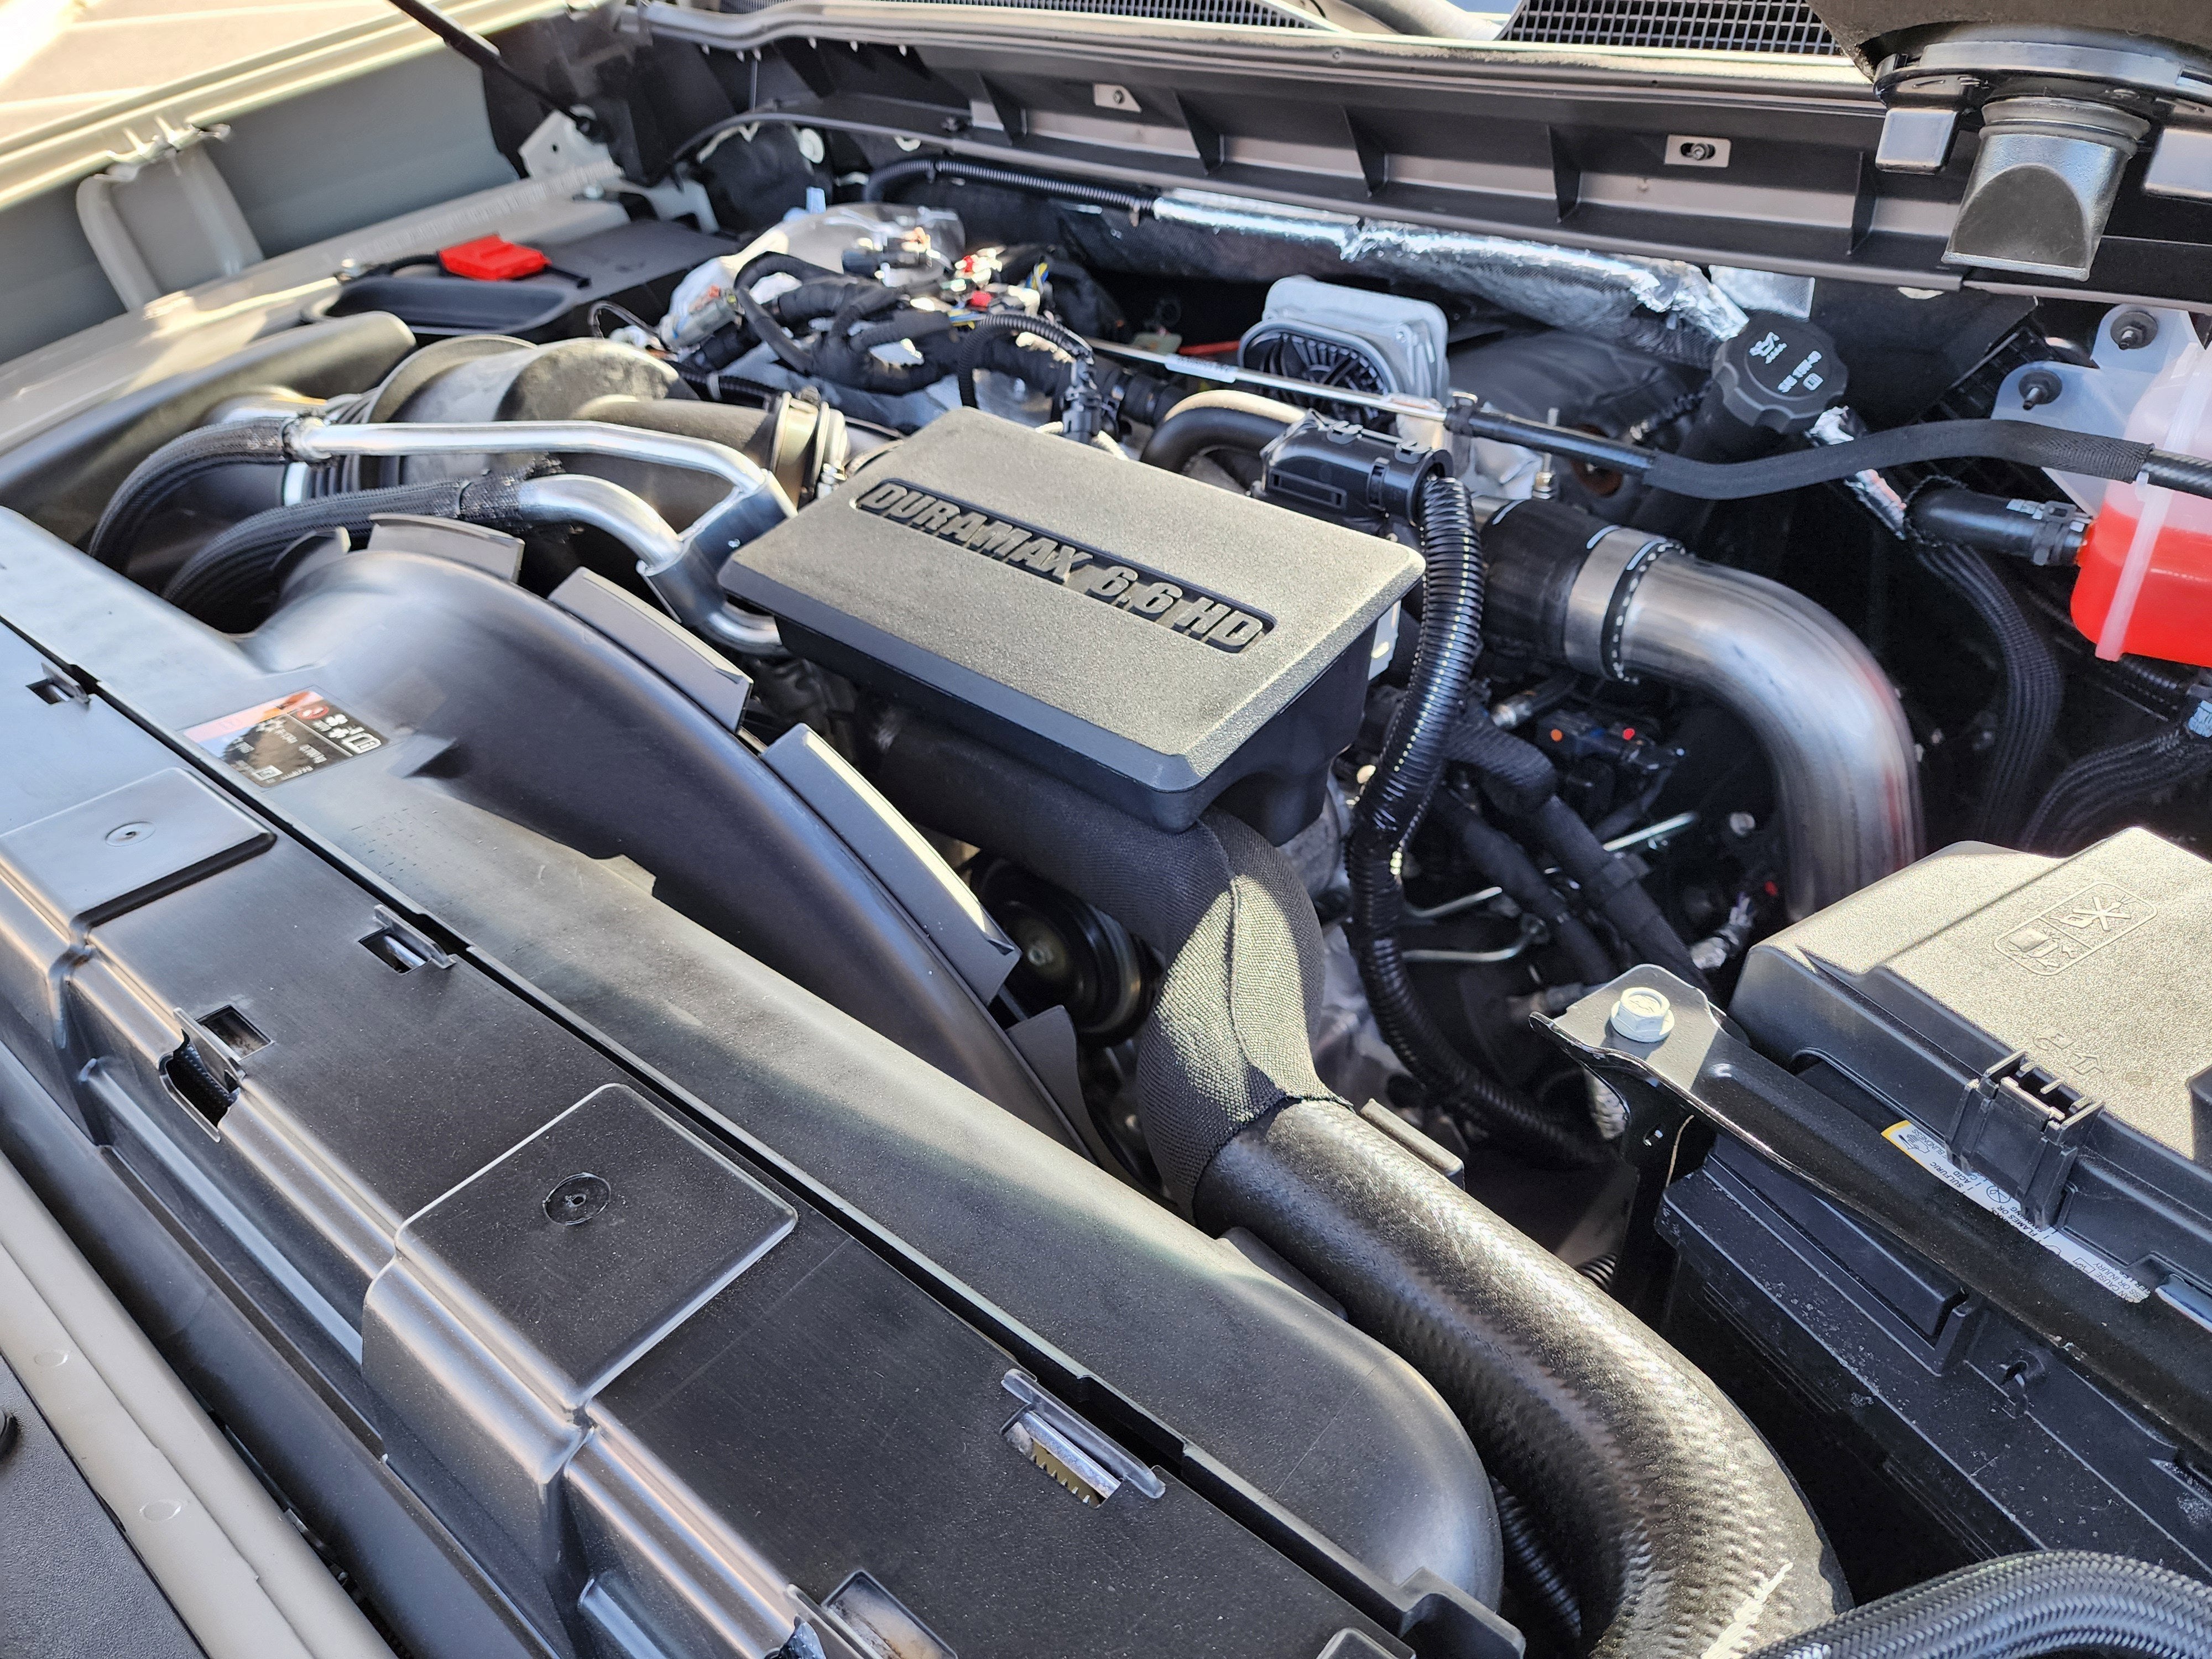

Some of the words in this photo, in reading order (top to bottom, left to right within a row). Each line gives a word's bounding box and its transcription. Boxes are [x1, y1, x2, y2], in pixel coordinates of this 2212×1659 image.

[871, 482, 1094, 583] DURAMAX
[1089, 565, 1183, 615] 6.6
[1172, 599, 1264, 647] HD
[1912, 1128, 1945, 1155] BLINDNESS
[1929, 1161, 1964, 1188] SULFURIC
[1953, 1171, 1971, 1183] ACID
[1997, 1206, 2009, 1214] OR
[2008, 1214, 2038, 1237] FLAMES
[2093, 1262, 2120, 1281] INJURY
[2094, 1272, 2120, 1291] CAUSE
[2117, 1280, 2131, 1290] OR
